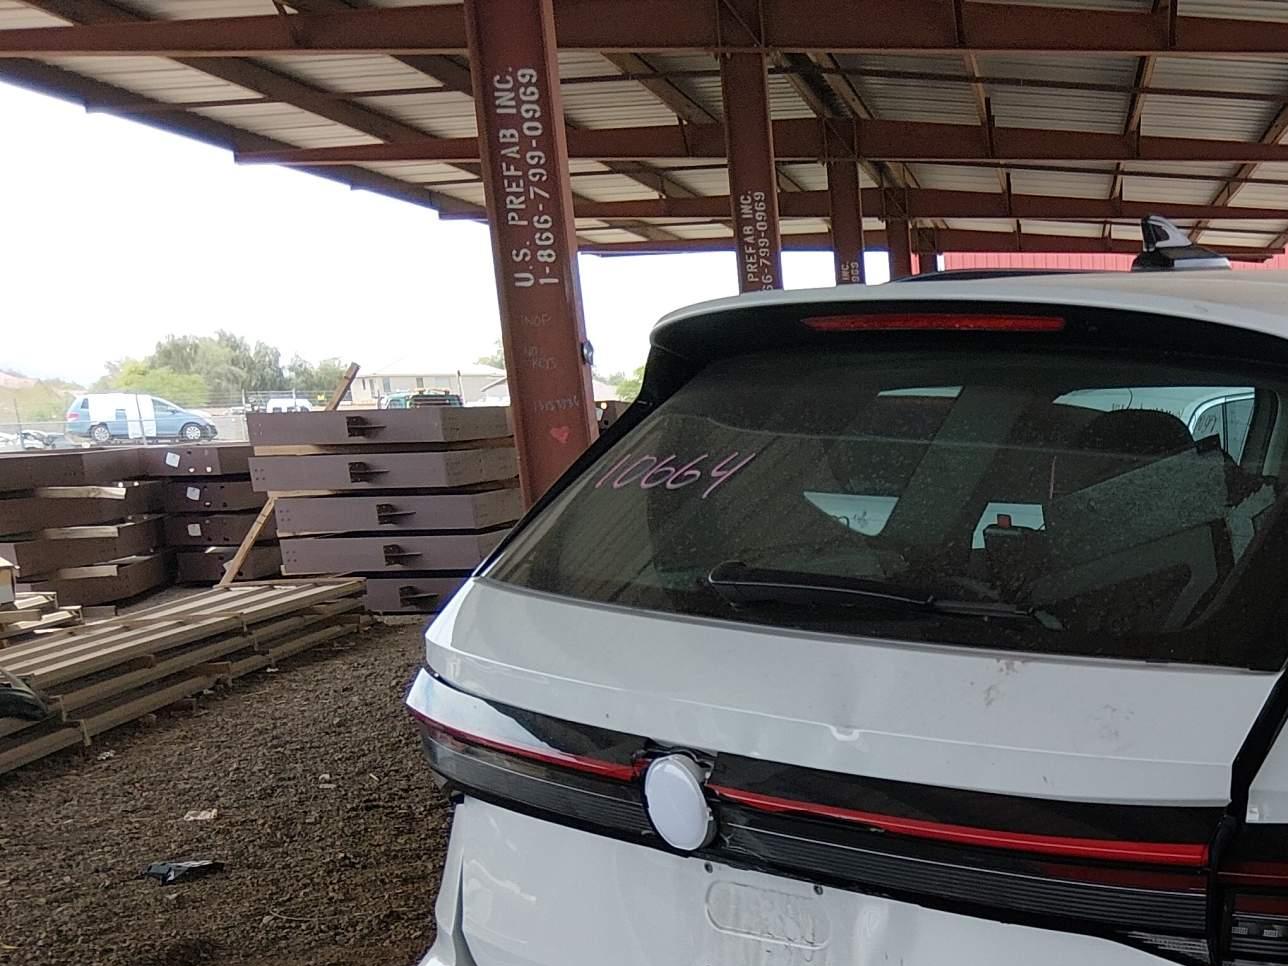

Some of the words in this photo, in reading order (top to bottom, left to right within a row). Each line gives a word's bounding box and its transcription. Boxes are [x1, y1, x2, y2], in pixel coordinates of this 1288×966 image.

[493, 66, 518, 115] INC.
[499, 128, 529, 226] PREFAB
[517, 68, 560, 285] 1-866-799-0969
[739, 190, 754, 219] INC.
[512, 240, 535, 288] U.S.
[743, 225, 760, 282] PREFAB
[595, 451, 757, 499] 10664
